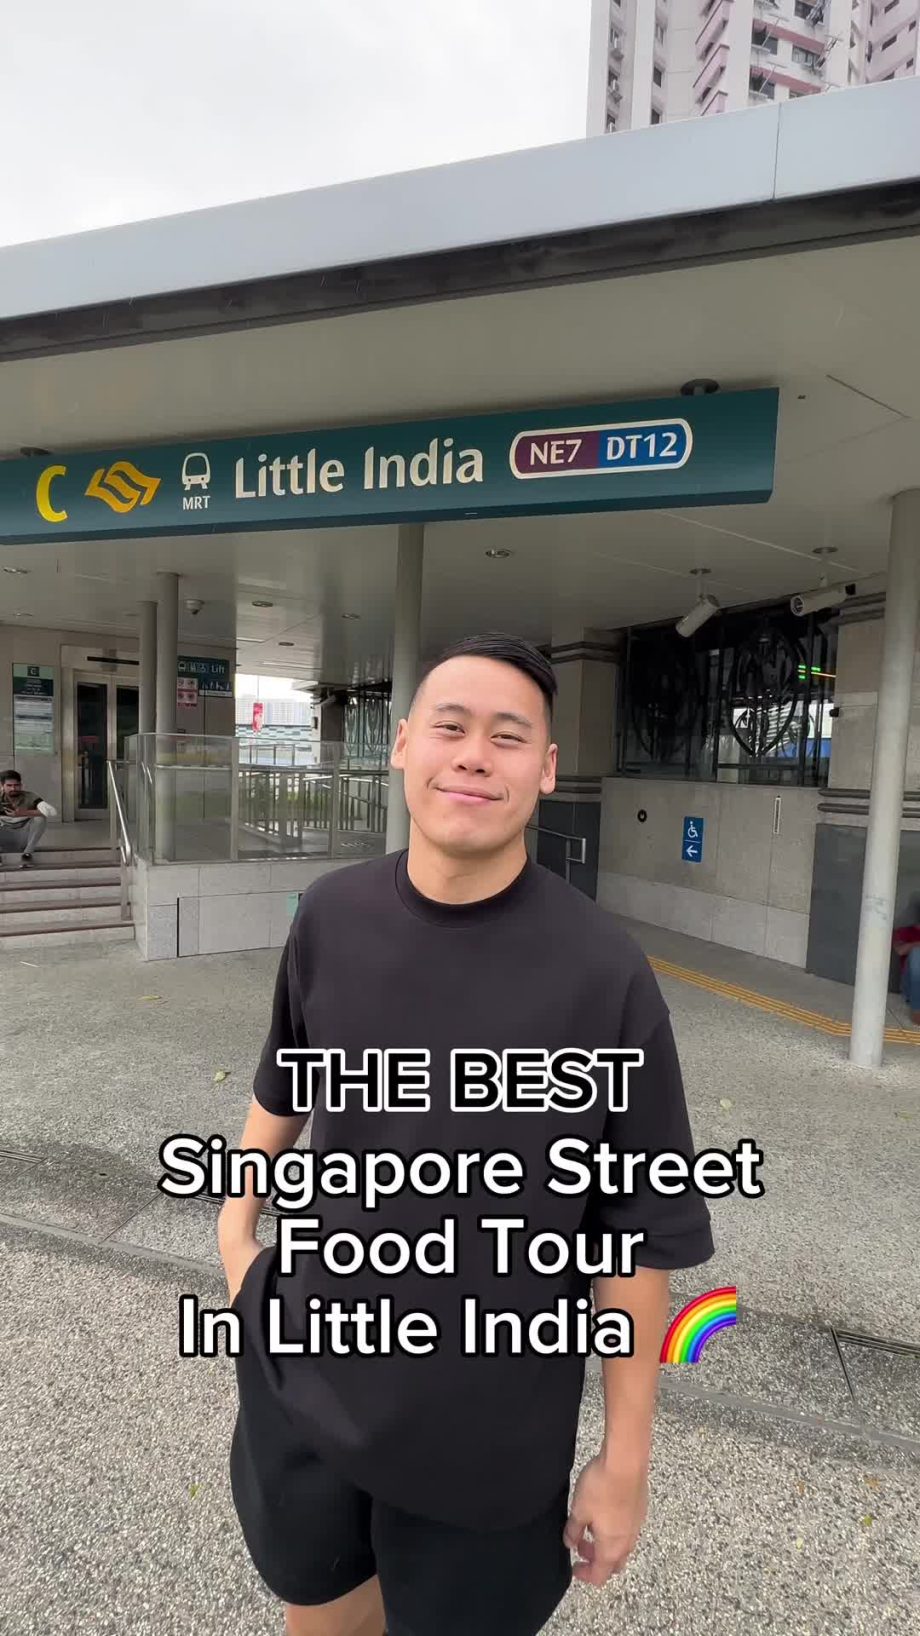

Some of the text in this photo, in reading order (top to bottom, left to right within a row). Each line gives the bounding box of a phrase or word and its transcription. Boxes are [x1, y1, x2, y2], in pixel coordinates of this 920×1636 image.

[35, 432, 678, 523] C MRT Little India NE7 DT12
